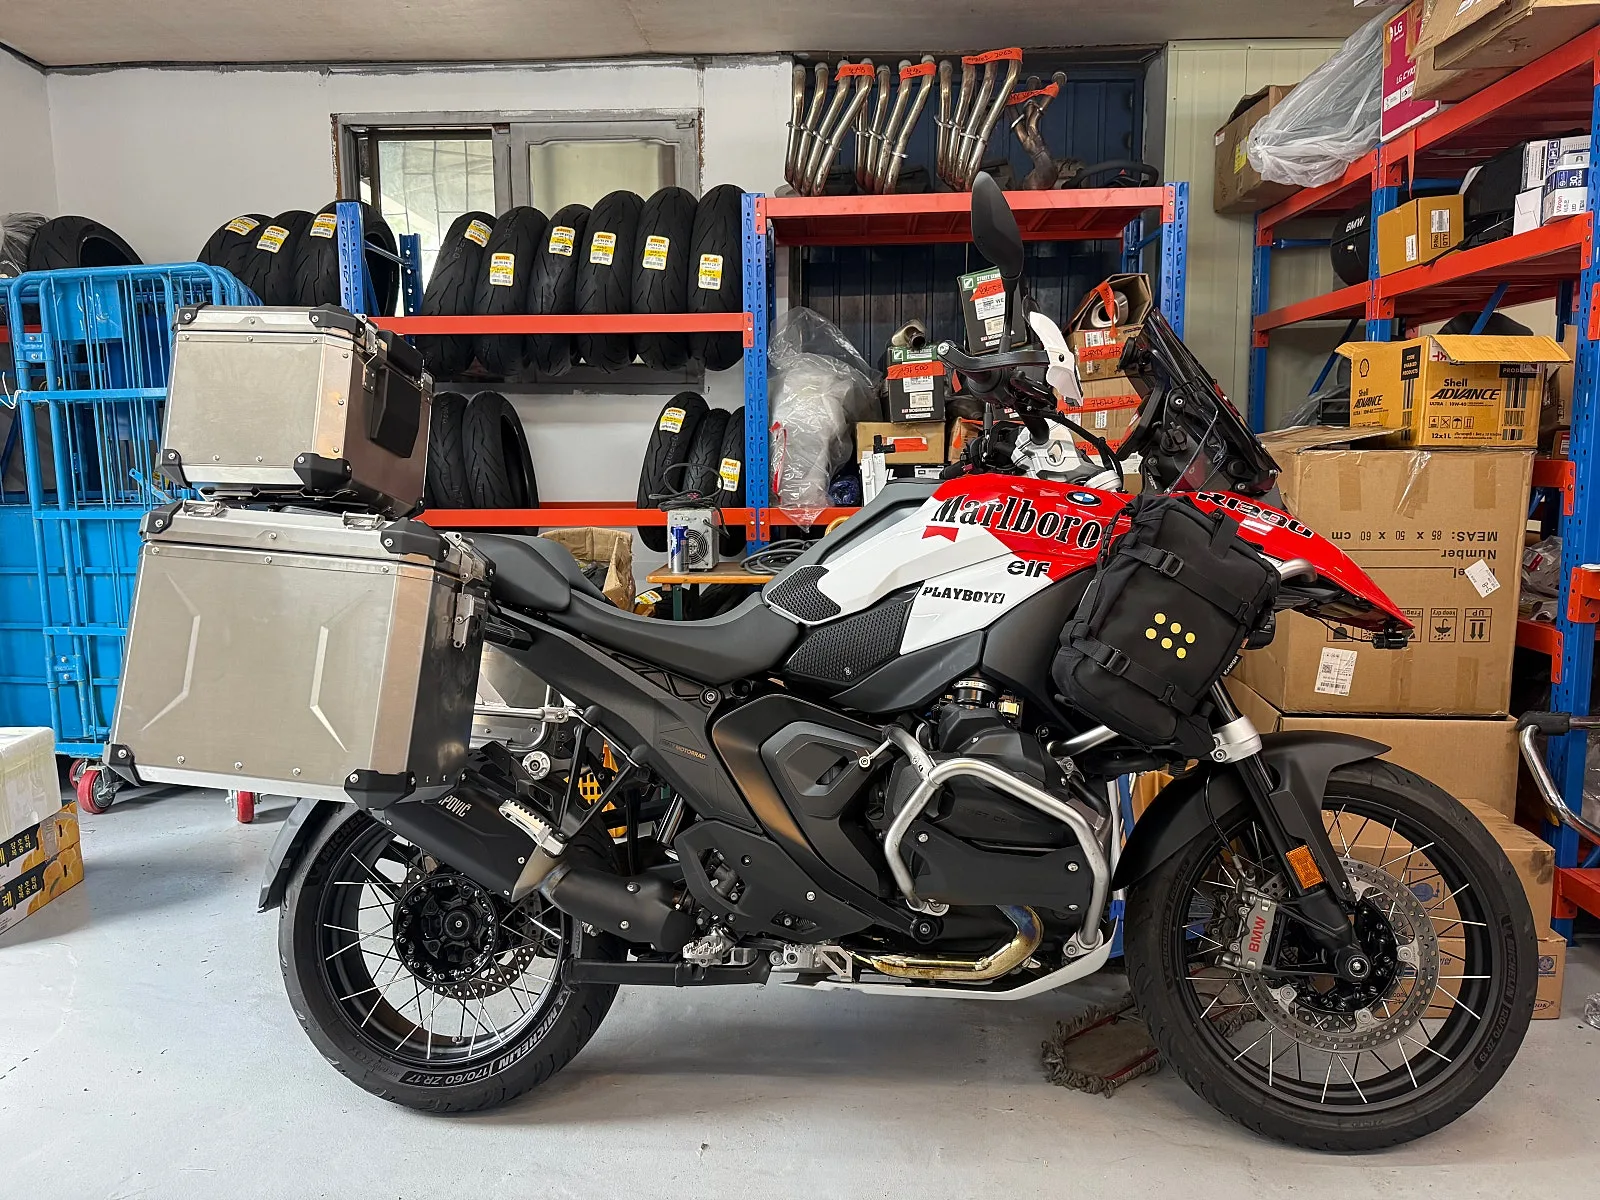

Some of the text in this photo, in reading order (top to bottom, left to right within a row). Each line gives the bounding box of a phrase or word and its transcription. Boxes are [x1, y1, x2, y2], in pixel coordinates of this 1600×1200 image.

[1394, 21, 1403, 36] LG
[1396, 74, 1403, 84] LG
[1346, 216, 1366, 232] BMW
[1444, 378, 1468, 387] Shell
[1358, 388, 1369, 397] Shell
[1430, 389, 1501, 400] ADVANCE
[1353, 395, 1383, 409] ADVANCE
[931, 494, 1102, 550] Marlboro
[1196, 492, 1314, 538] R1300
[1331, 531, 1351, 540] cm
[1360, 530, 1372, 541] 60
[1395, 530, 1405, 541] 50
[1431, 530, 1442, 541] 85
[1451, 531, 1498, 542] MEAS:
[1441, 549, 1496, 560] Number
[1007, 560, 1051, 578] elf
[675, 745, 706, 760] MOTORRAD
[438, 795, 472, 818] POVIČ
[1248, 916, 1266, 953] BMW
[1505, 938, 1517, 998] MICHELIN
[406, 1007, 558, 1085] MICHELIN 170/60 ZR 17
